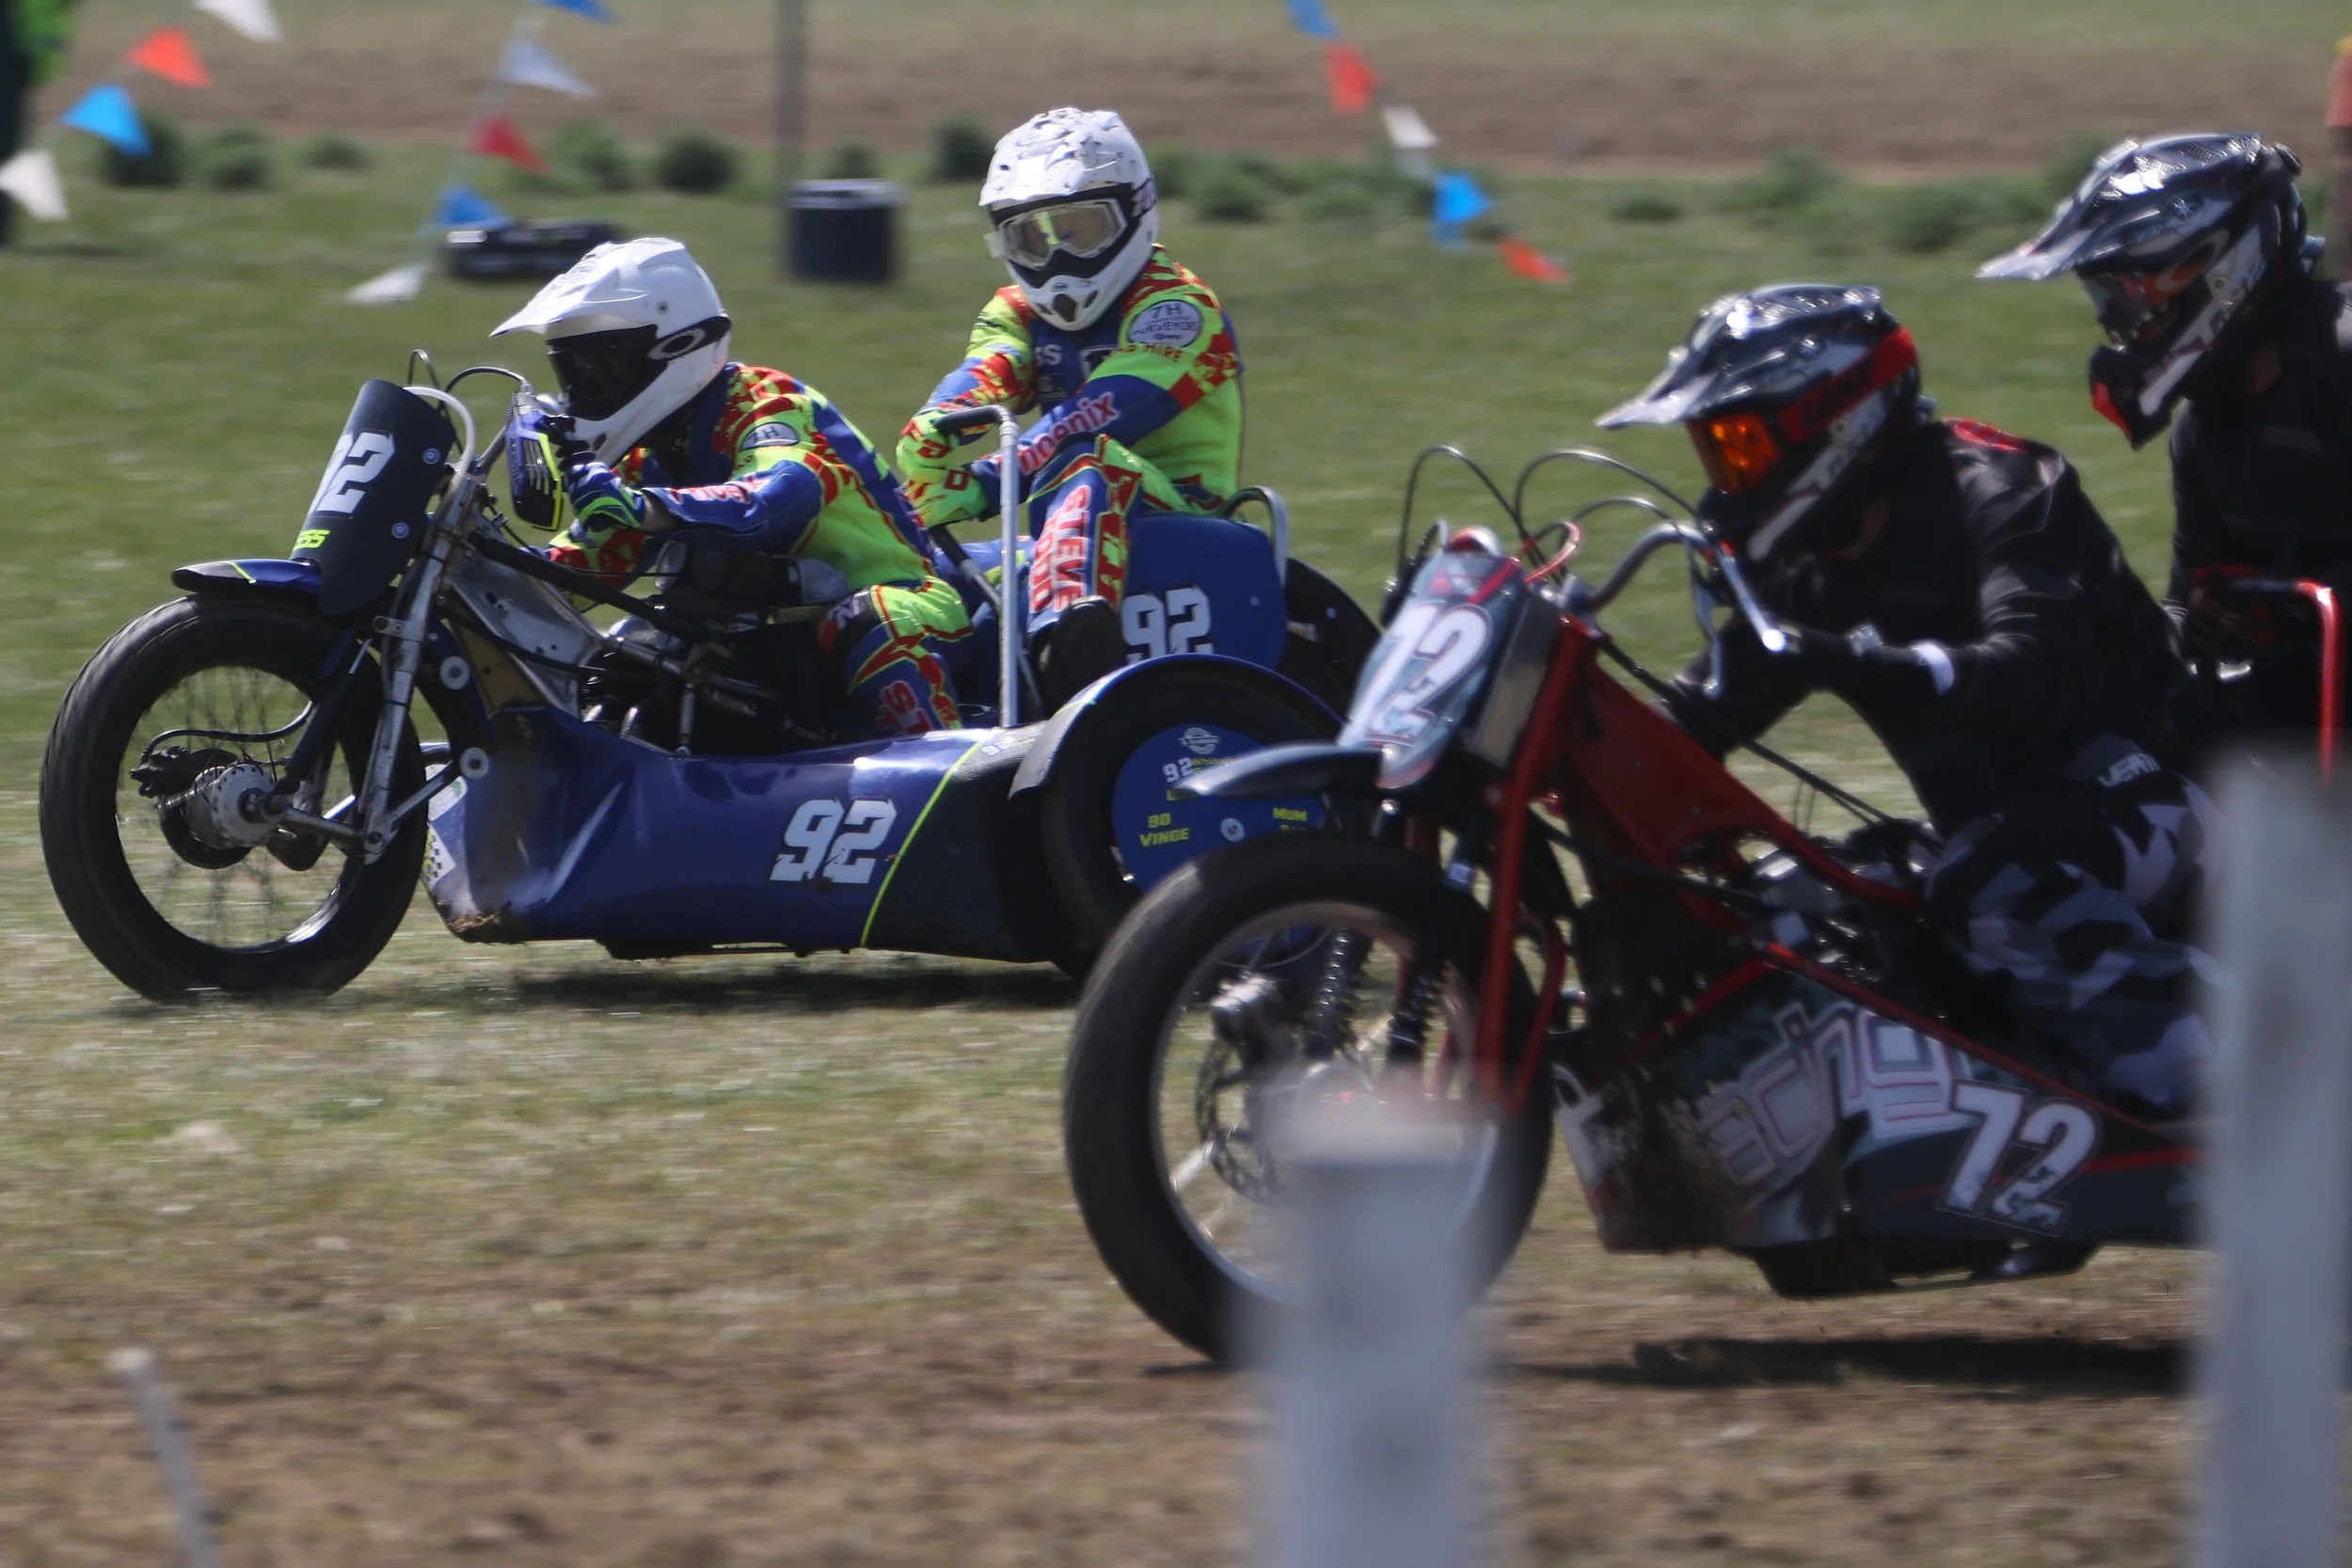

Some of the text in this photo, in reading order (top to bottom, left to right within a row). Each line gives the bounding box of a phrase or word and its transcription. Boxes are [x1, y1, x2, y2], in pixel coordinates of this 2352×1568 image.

[1121, 584, 1215, 664] 92
[1163, 756, 1195, 783] 92
[770, 798, 898, 884] 92
[1944, 1081, 2097, 1235] 72
